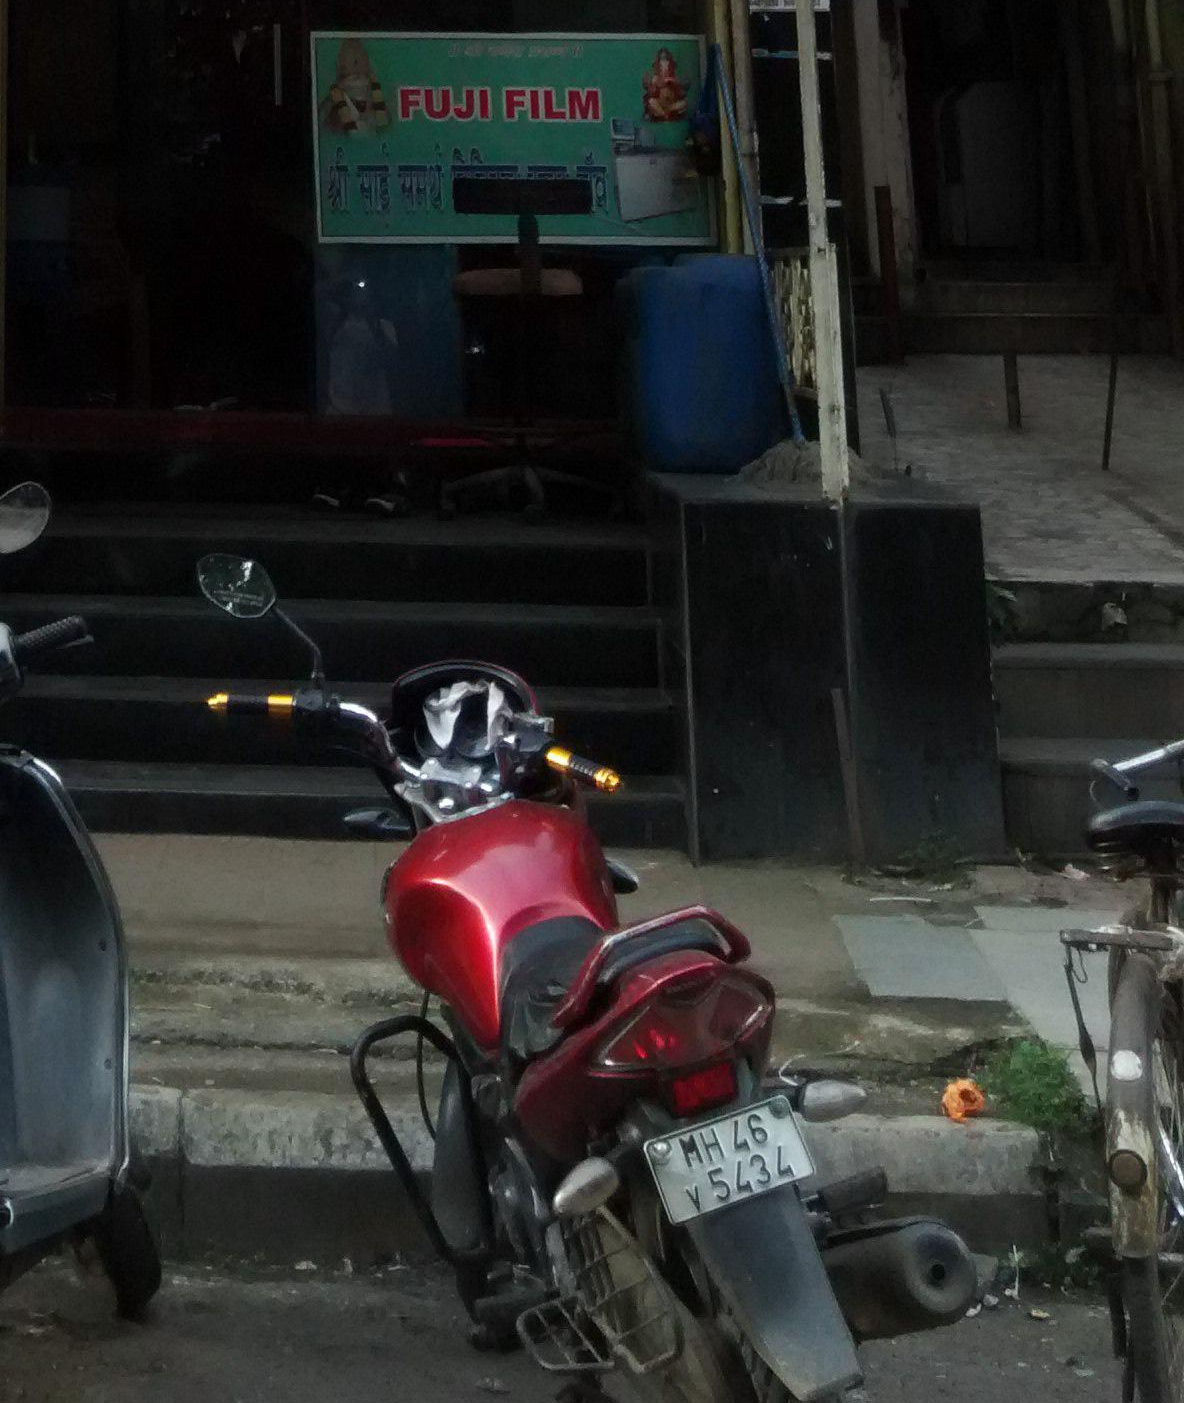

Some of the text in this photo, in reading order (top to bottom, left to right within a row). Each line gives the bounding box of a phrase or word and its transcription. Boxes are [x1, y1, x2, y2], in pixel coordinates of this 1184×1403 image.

[398, 86, 603, 123] FUJI FILM
[679, 1113, 769, 1169] MH 46
[707, 1145, 795, 1202] 5434
